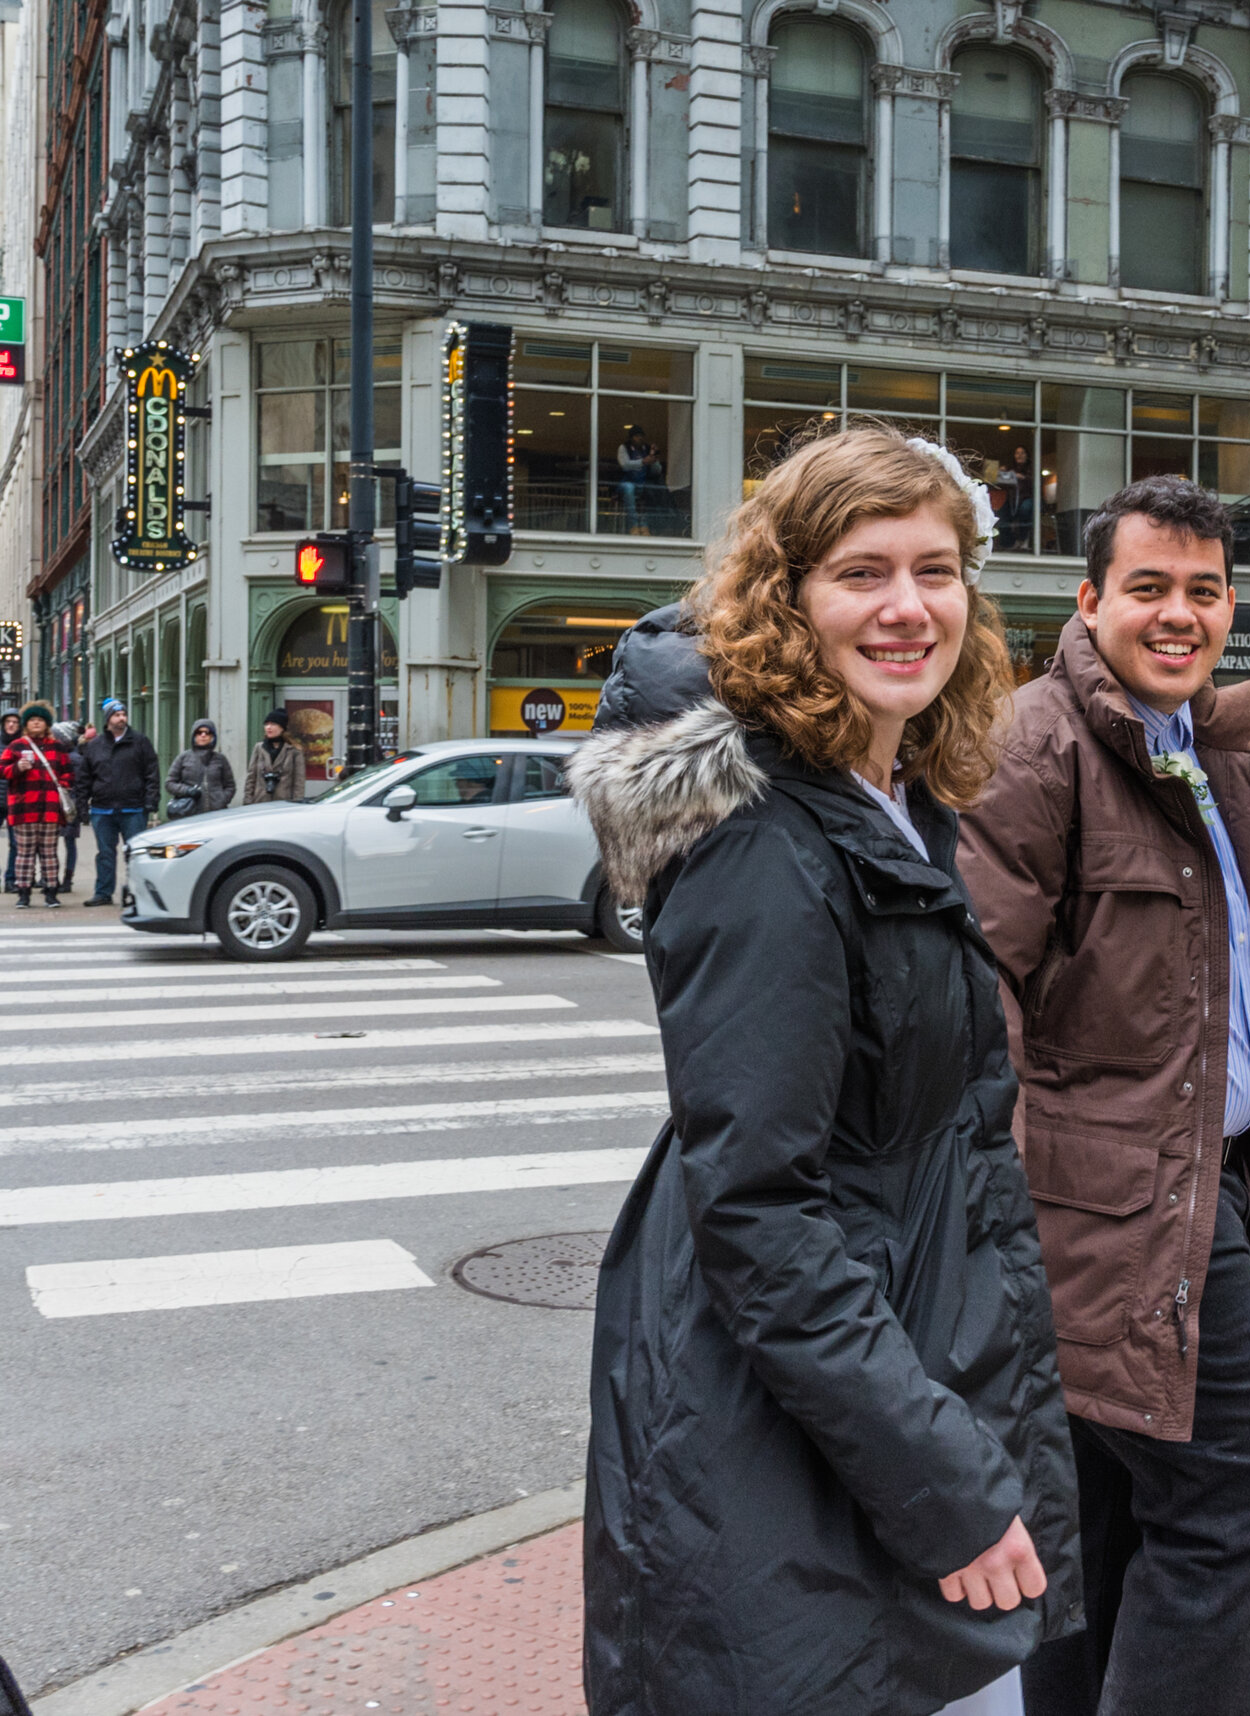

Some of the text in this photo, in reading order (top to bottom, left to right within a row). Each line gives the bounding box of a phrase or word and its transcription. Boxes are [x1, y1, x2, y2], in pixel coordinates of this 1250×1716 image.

[282, 651, 304, 668] Are
[302, 656, 329, 674] you
[524, 703, 563, 720] new
